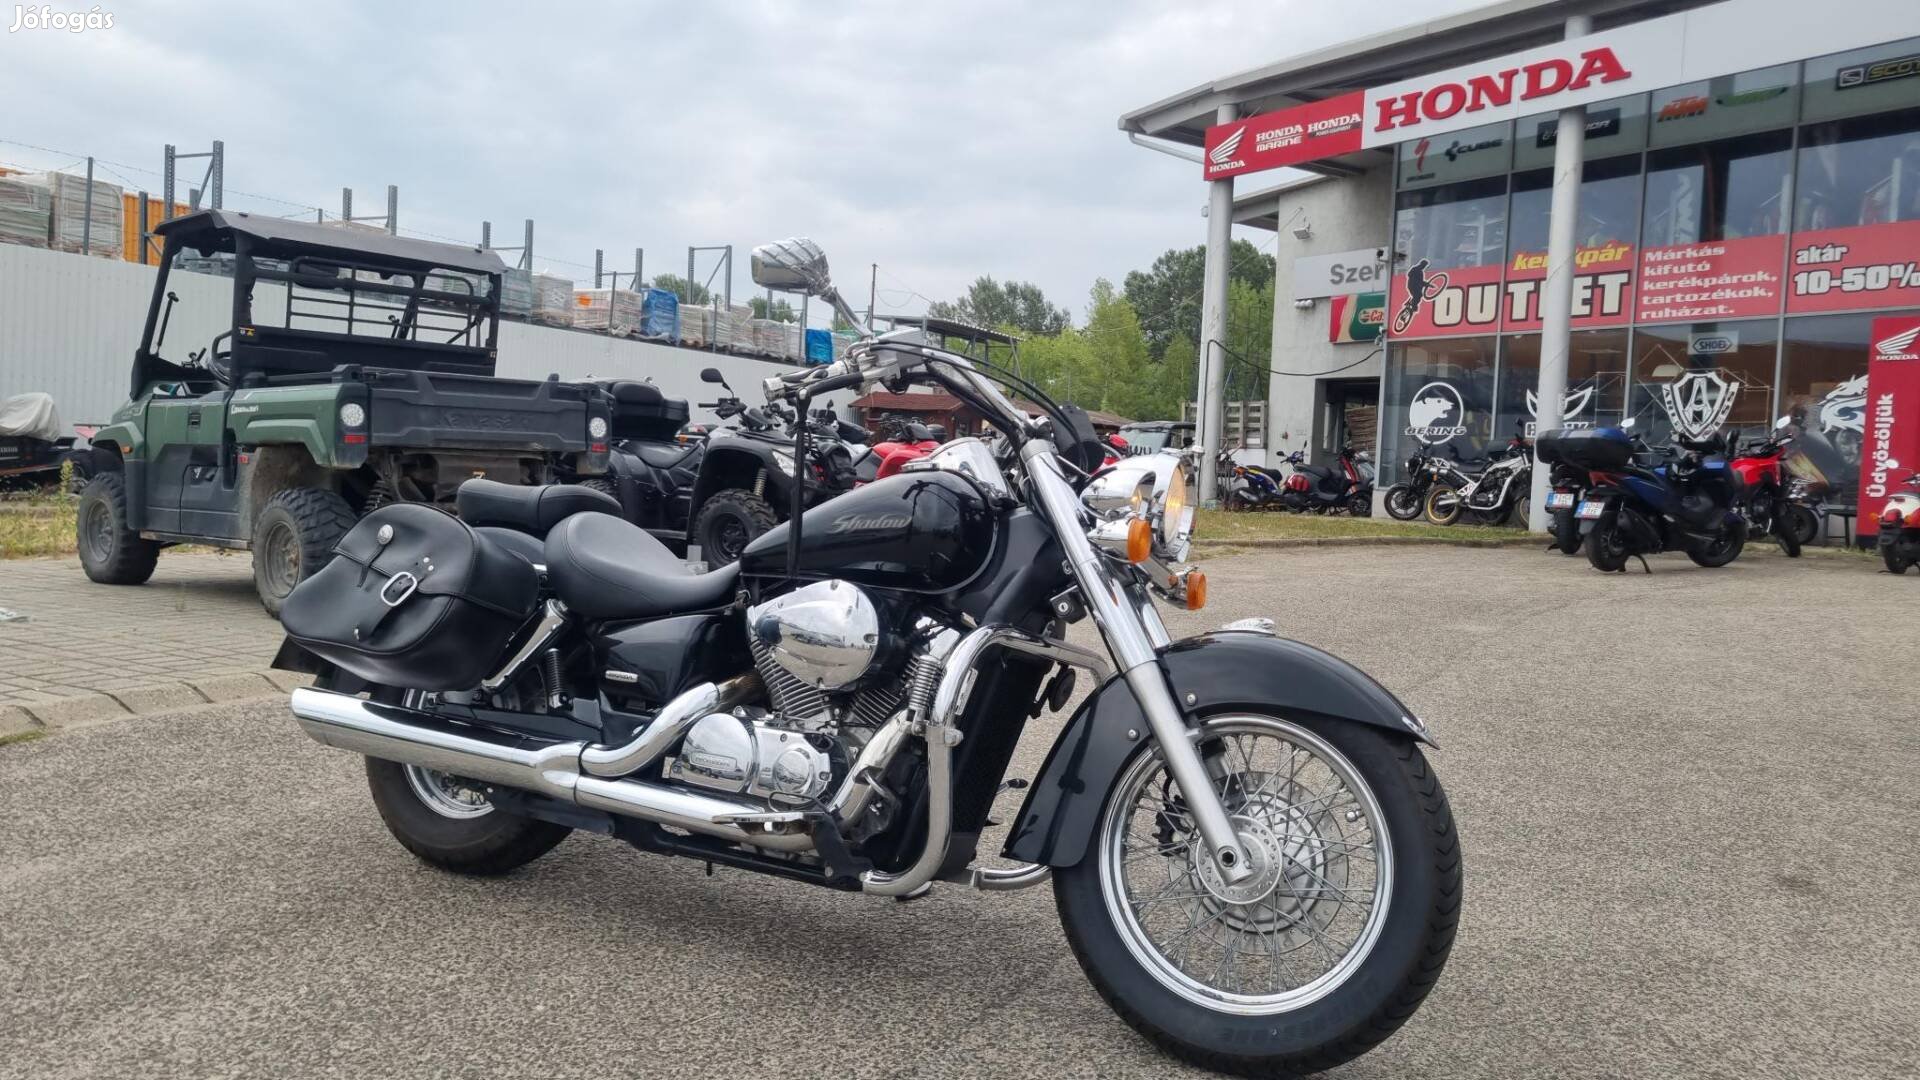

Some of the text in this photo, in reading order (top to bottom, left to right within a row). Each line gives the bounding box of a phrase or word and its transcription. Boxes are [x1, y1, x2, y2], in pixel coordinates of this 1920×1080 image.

[1374, 47, 1632, 133] HONDA
[1307, 112, 1361, 133] HONDA
[1256, 124, 1303, 142] HONDA
[1256, 136, 1302, 152] MARINE
[1209, 159, 1245, 173] HONDA
[1513, 244, 1629, 271] kerkpár
[1645, 245, 1725, 262] Márkás
[1796, 244, 1847, 264] akár
[1644, 261, 1711, 276] kifutó
[1643, 271, 1777, 291] kerékpárok,
[1794, 263, 1920, 295] 10-50%
[1433, 273, 1628, 325] OUTET
[1642, 286, 1773, 305] tartozékok,
[1641, 304, 1734, 319] ruházat.
[1875, 354, 1918, 362] HONDA
[1406, 426, 1467, 436] BERING
[1866, 393, 1895, 497] Üdvözöljük
[828, 514, 912, 534] Shadow
